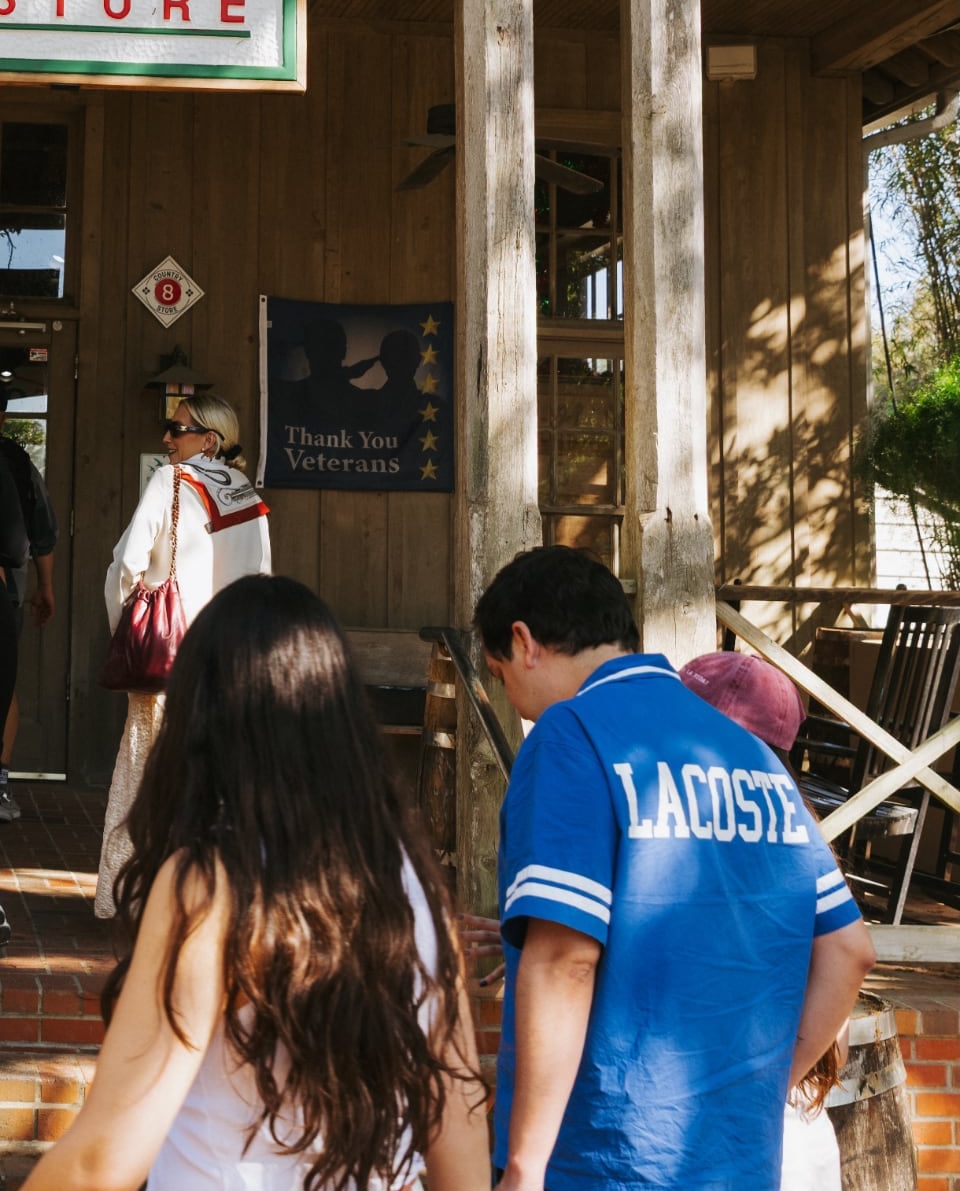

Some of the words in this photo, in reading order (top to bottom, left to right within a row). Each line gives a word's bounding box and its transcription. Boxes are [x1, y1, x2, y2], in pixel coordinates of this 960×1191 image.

[154, 271, 183, 281] COUNTRY
[162, 284, 174, 301] 8
[285, 426, 352, 448] Thank
[358, 431, 398, 449] You
[284, 448, 400, 473] Veterans
[614, 762, 809, 844] LACOSTE
